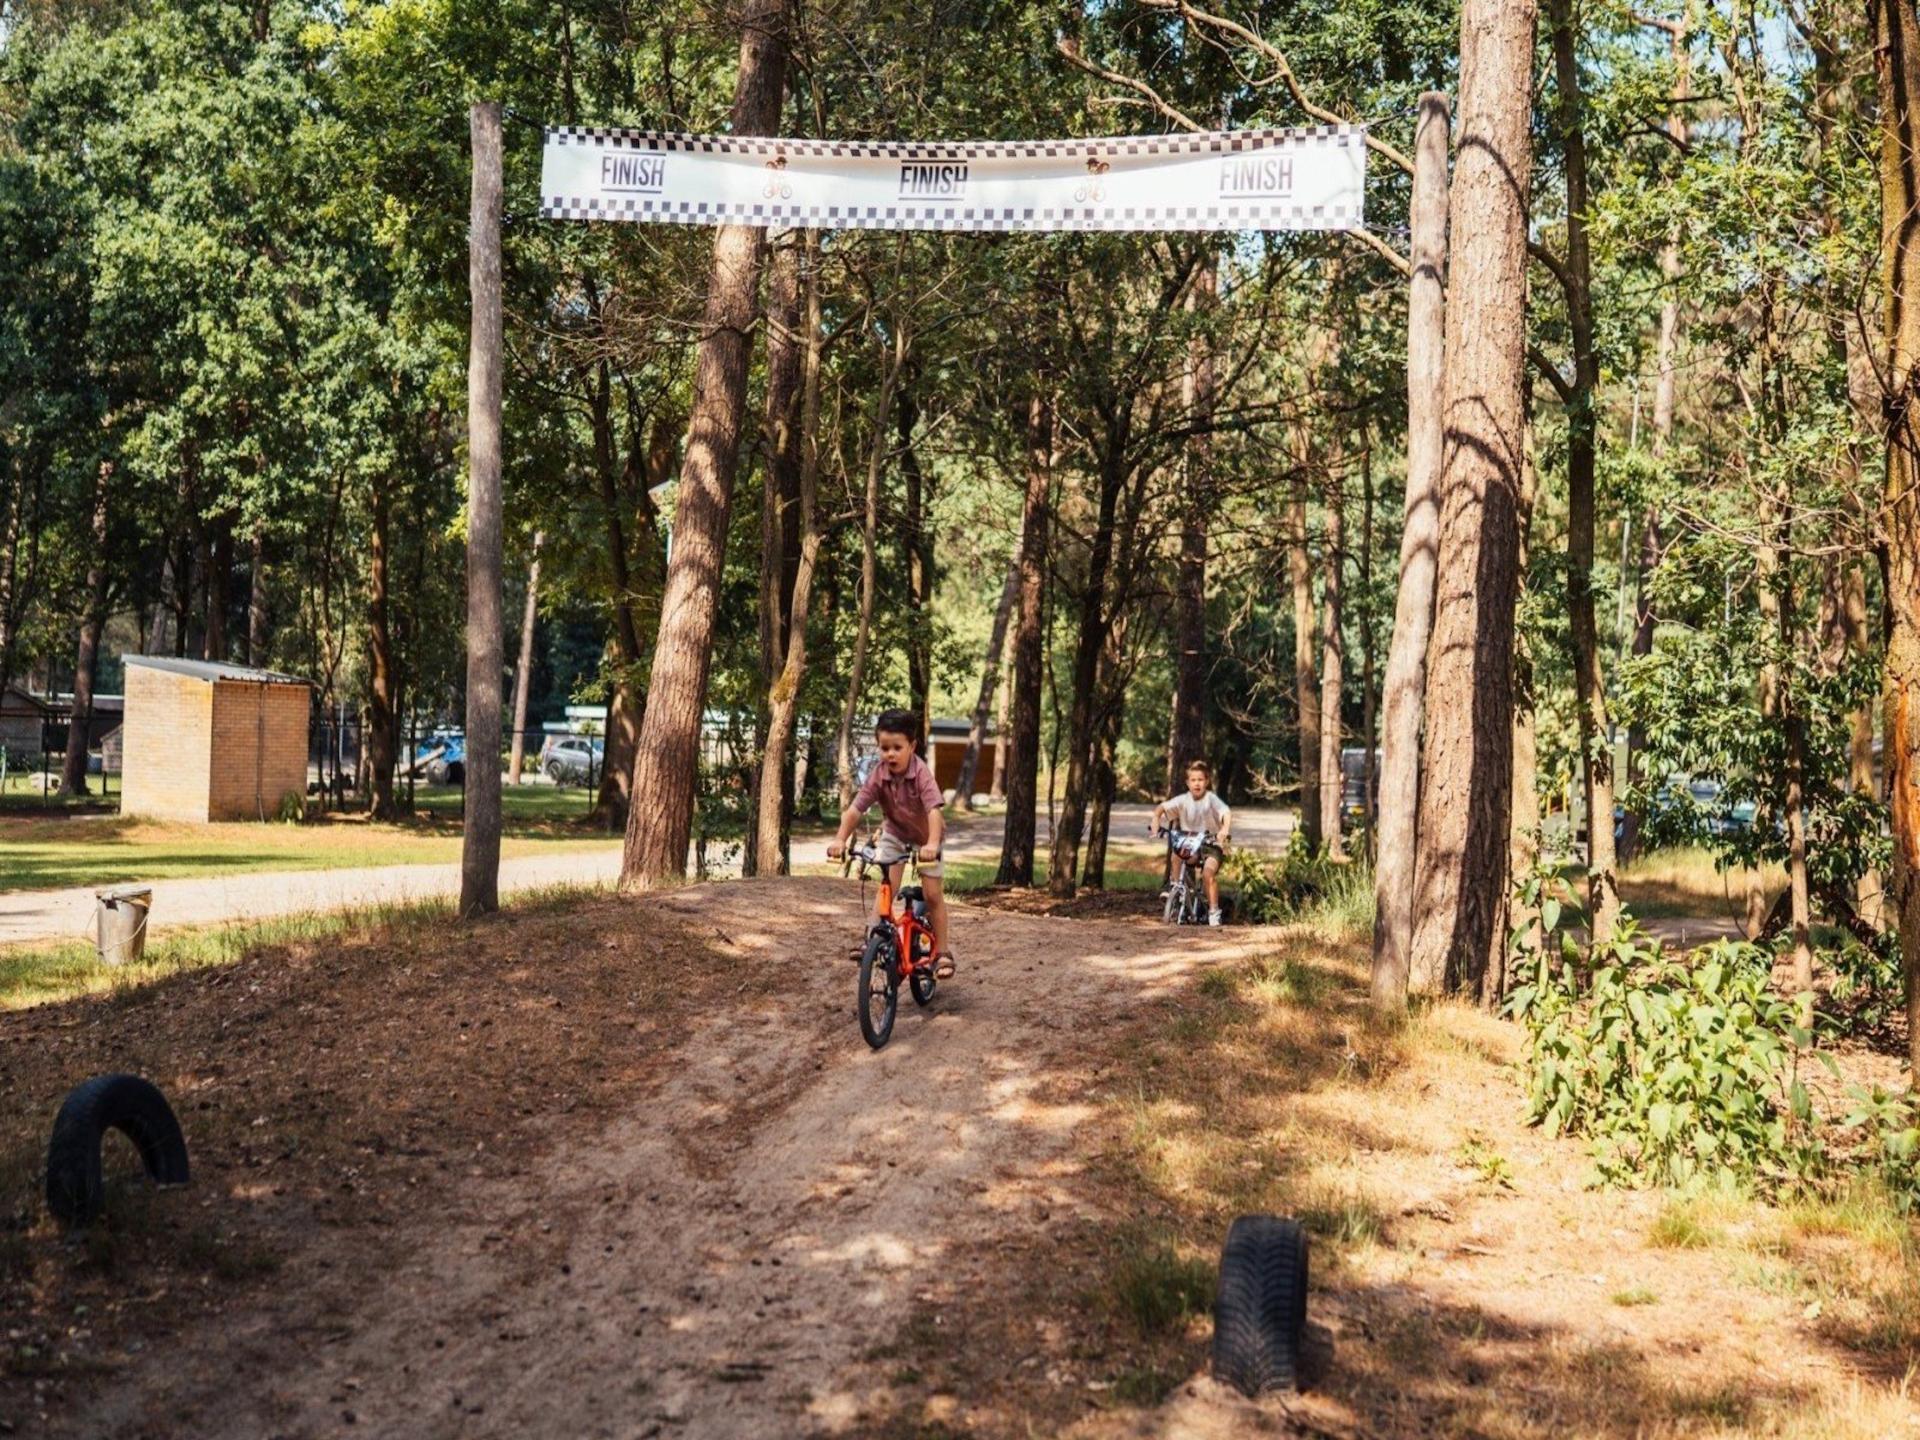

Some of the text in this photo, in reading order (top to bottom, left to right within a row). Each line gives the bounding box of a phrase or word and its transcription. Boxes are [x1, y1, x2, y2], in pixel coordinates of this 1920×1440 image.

[601, 156, 665, 187] FINISH
[900, 165, 968, 195] FINISH
[1220, 158, 1293, 191] FINISH
